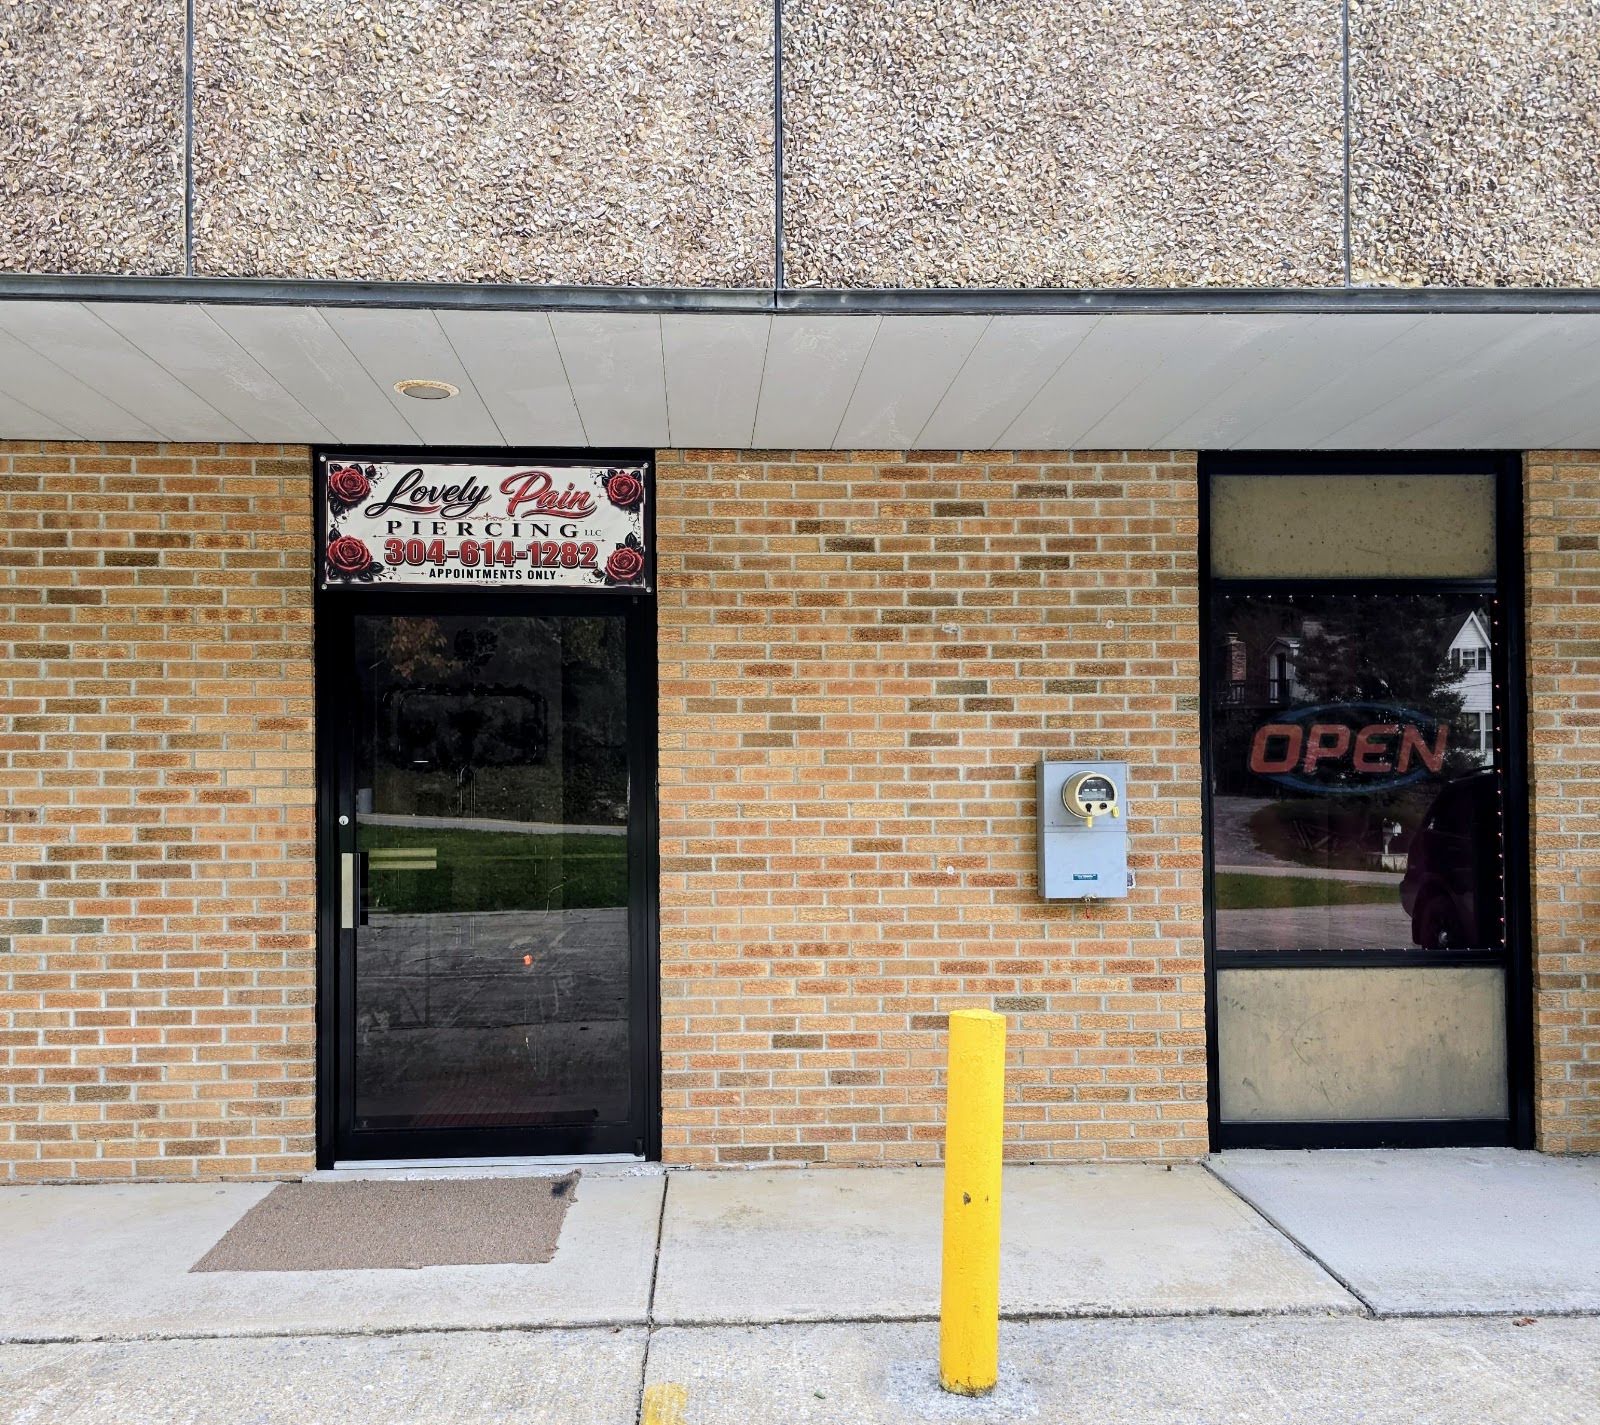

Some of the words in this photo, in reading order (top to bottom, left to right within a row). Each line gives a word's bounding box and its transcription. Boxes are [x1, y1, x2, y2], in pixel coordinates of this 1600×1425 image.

[365, 468, 491, 519] Lovely
[500, 471, 598, 518] Pain
[386, 520, 579, 538] PIERCING
[584, 529, 602, 537] LLC
[384, 538, 599, 569] 304-614-1282
[429, 568, 522, 580] APPOINTMENTS
[527, 569, 557, 580] ONLY
[1250, 724, 1449, 773] OPEN
